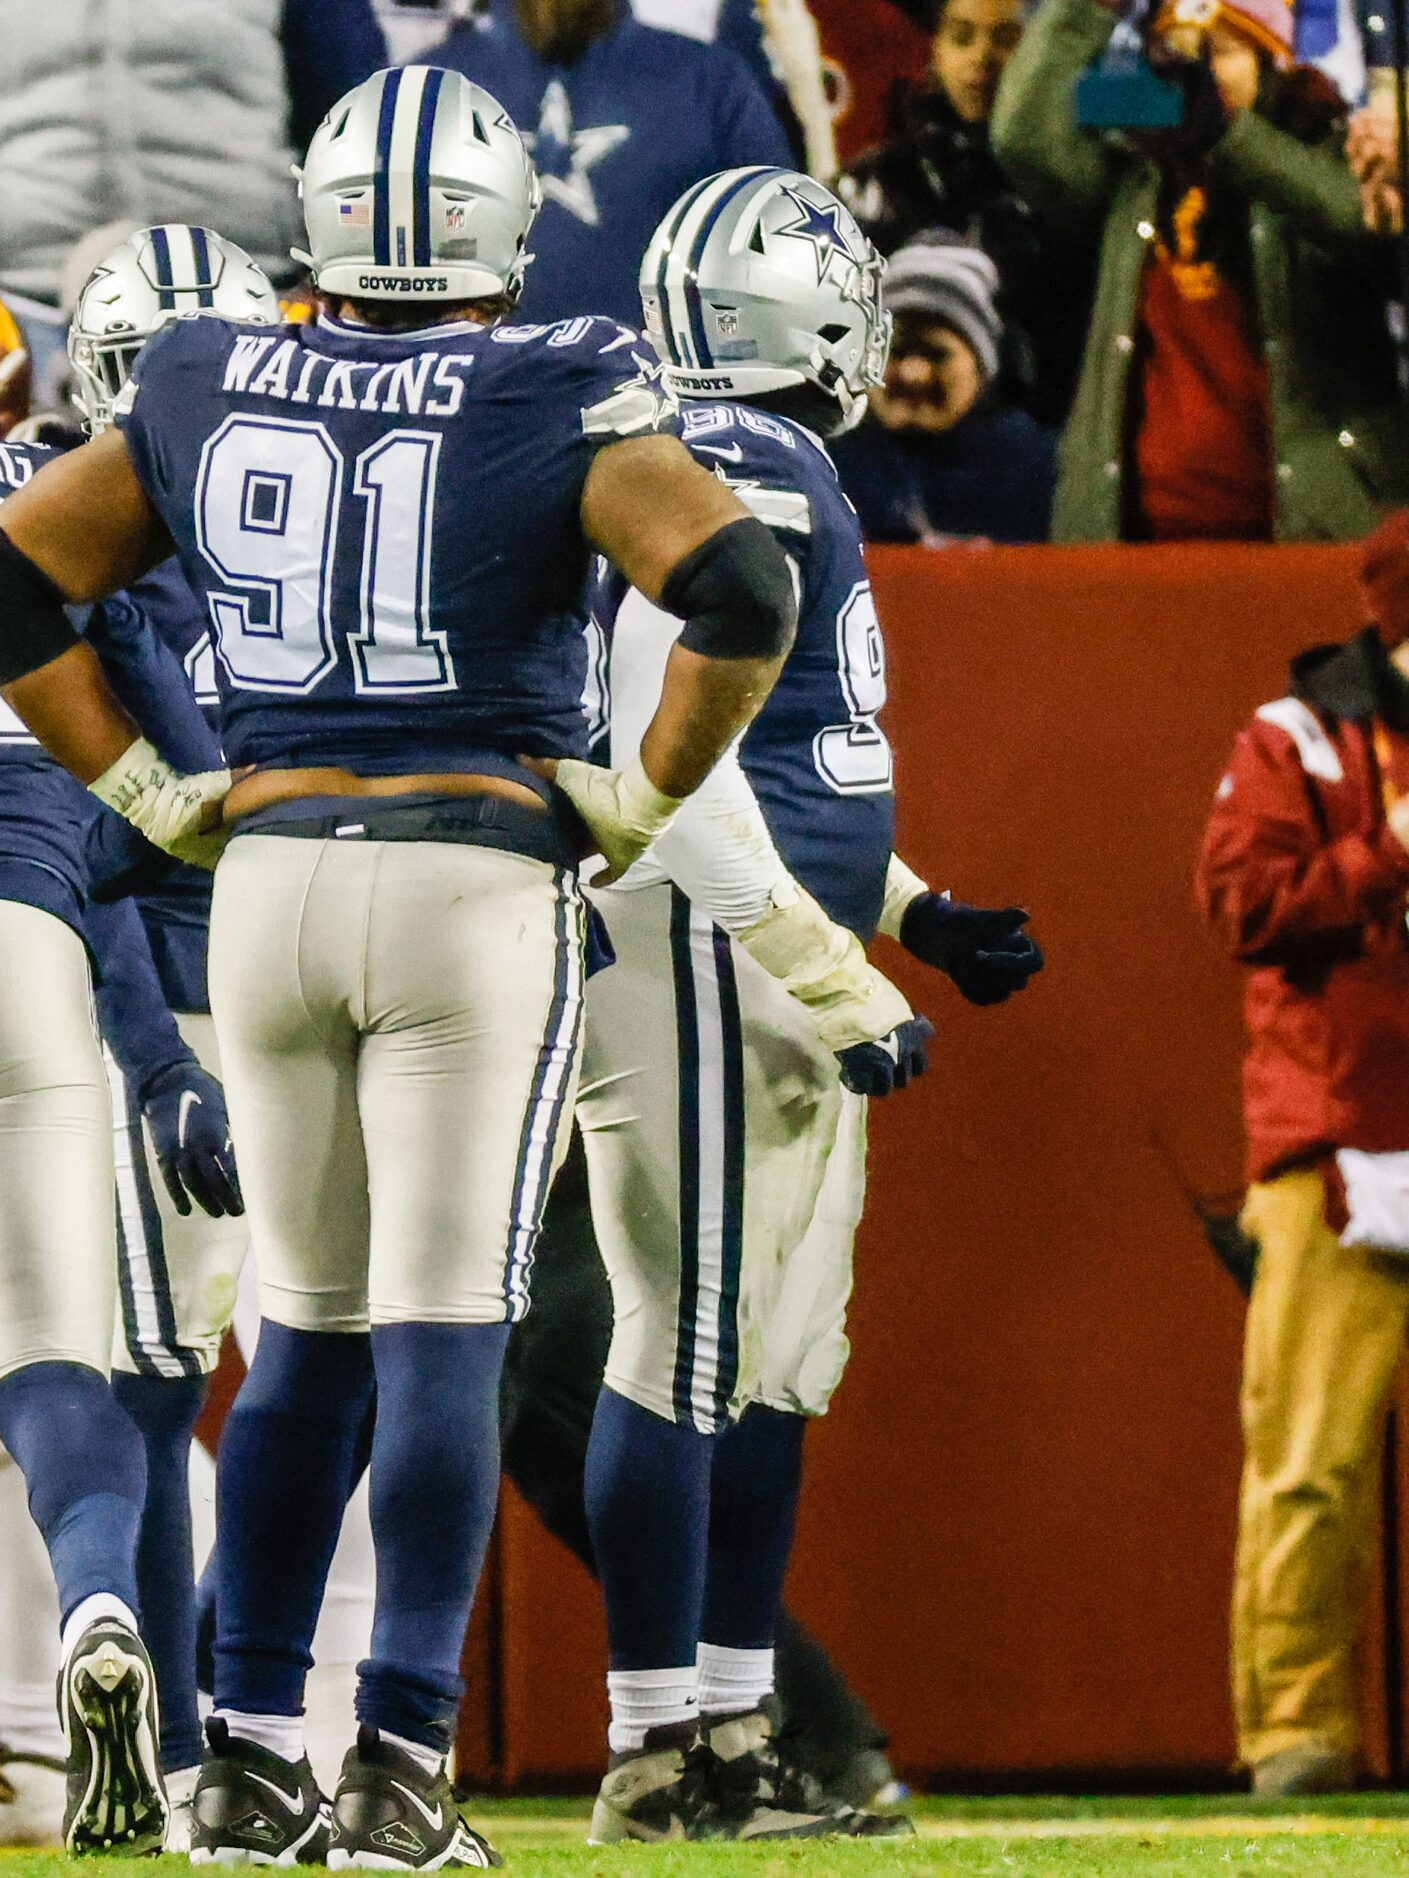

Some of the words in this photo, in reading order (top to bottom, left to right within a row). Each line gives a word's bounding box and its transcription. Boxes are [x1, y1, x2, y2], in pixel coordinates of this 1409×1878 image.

[359, 275, 448, 292] COWBOYS
[222, 335, 474, 415] WATKINS
[194, 411, 459, 695] 91
